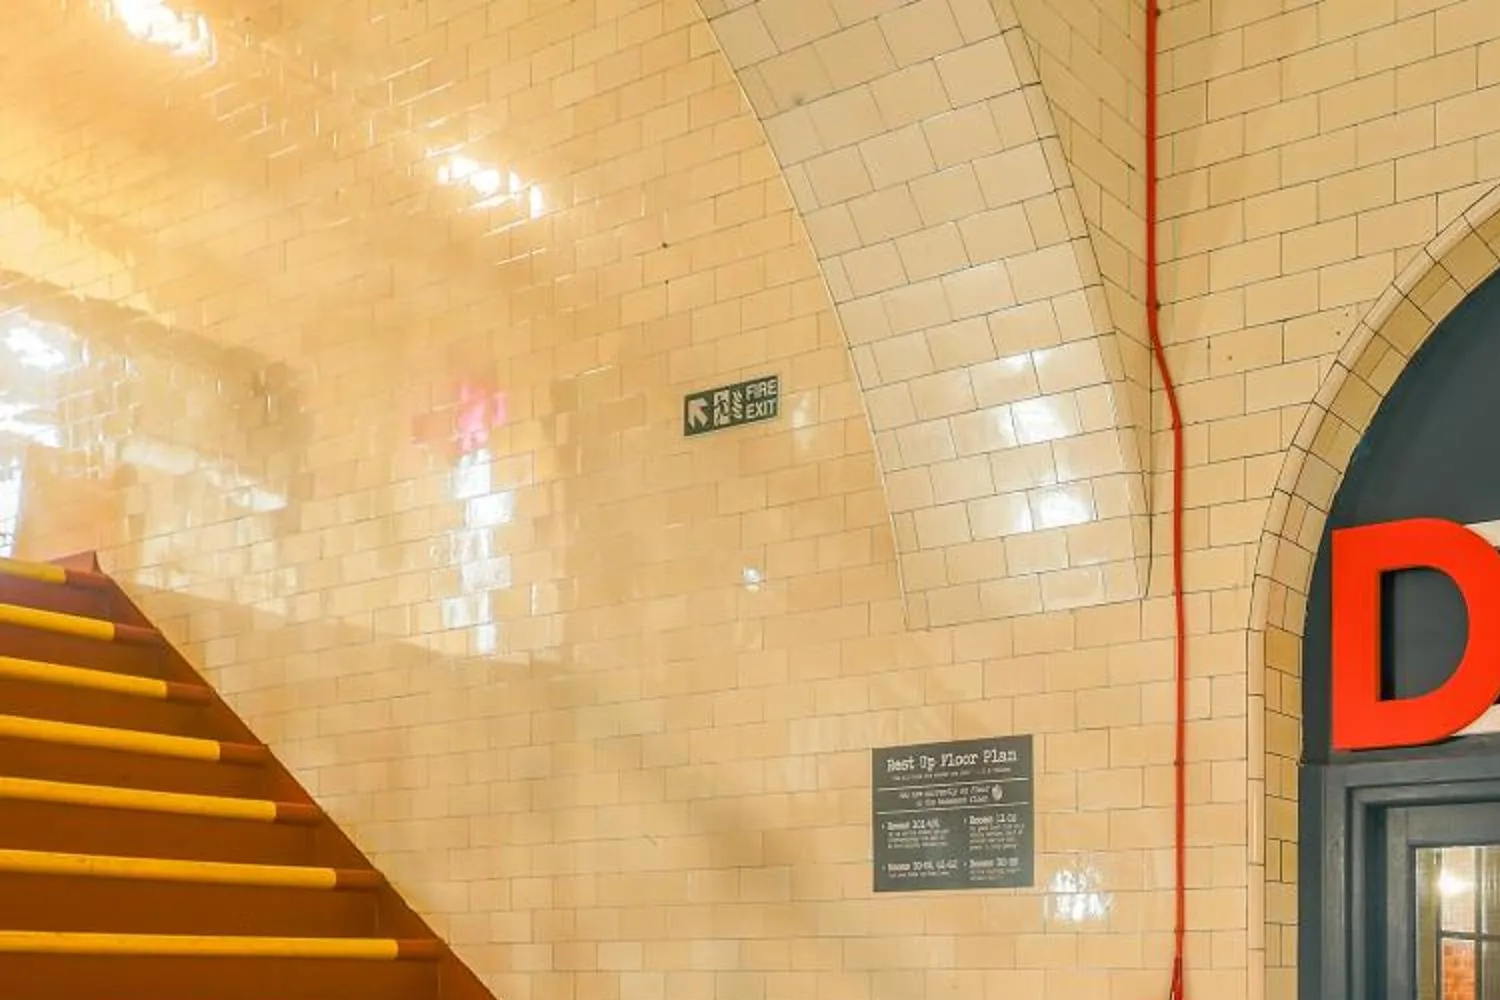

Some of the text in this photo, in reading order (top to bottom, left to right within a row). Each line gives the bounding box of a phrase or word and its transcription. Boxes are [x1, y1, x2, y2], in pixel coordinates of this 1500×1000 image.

[745, 379, 776, 401] FIRE
[745, 399, 777, 419] EXIT
[940, 752, 979, 767] Floor
[983, 749, 1018, 765] Plan
